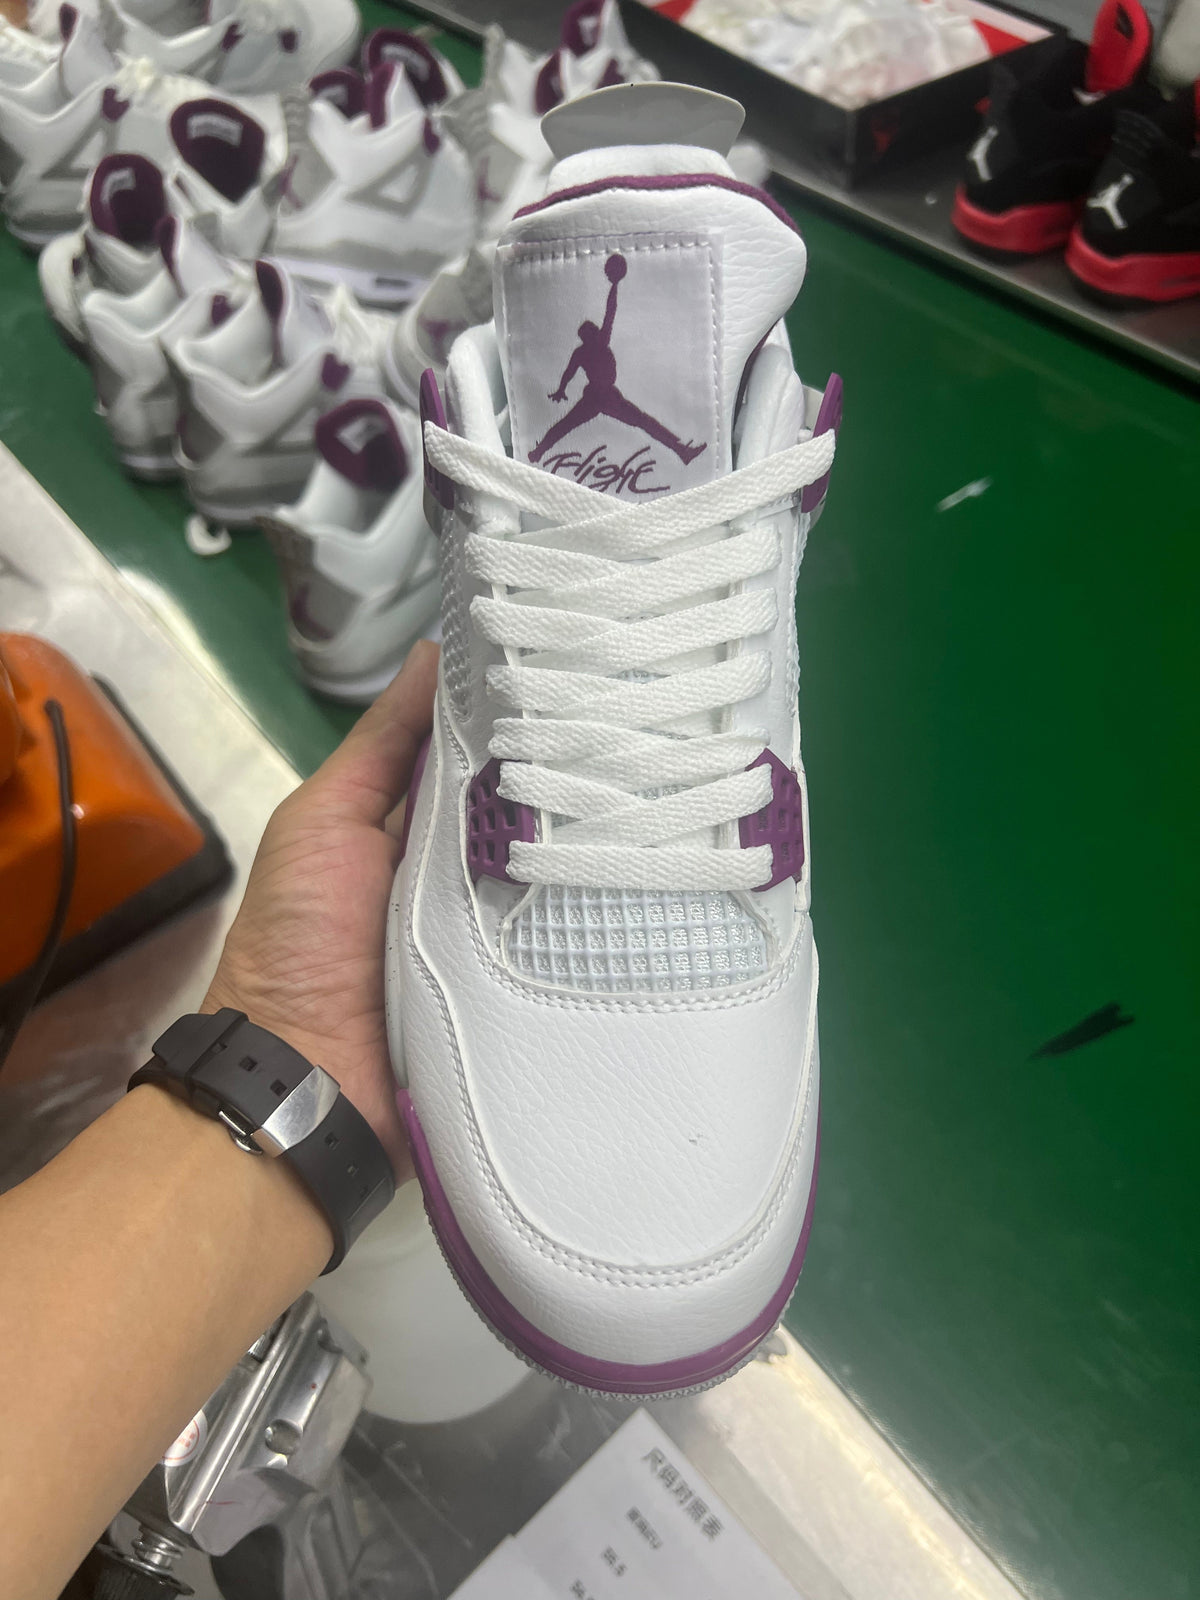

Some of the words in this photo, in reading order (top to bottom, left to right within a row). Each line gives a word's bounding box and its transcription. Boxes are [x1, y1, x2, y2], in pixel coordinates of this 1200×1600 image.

[542, 444, 671, 494] Flight
[641, 1447, 724, 1541] 尺码对照表
